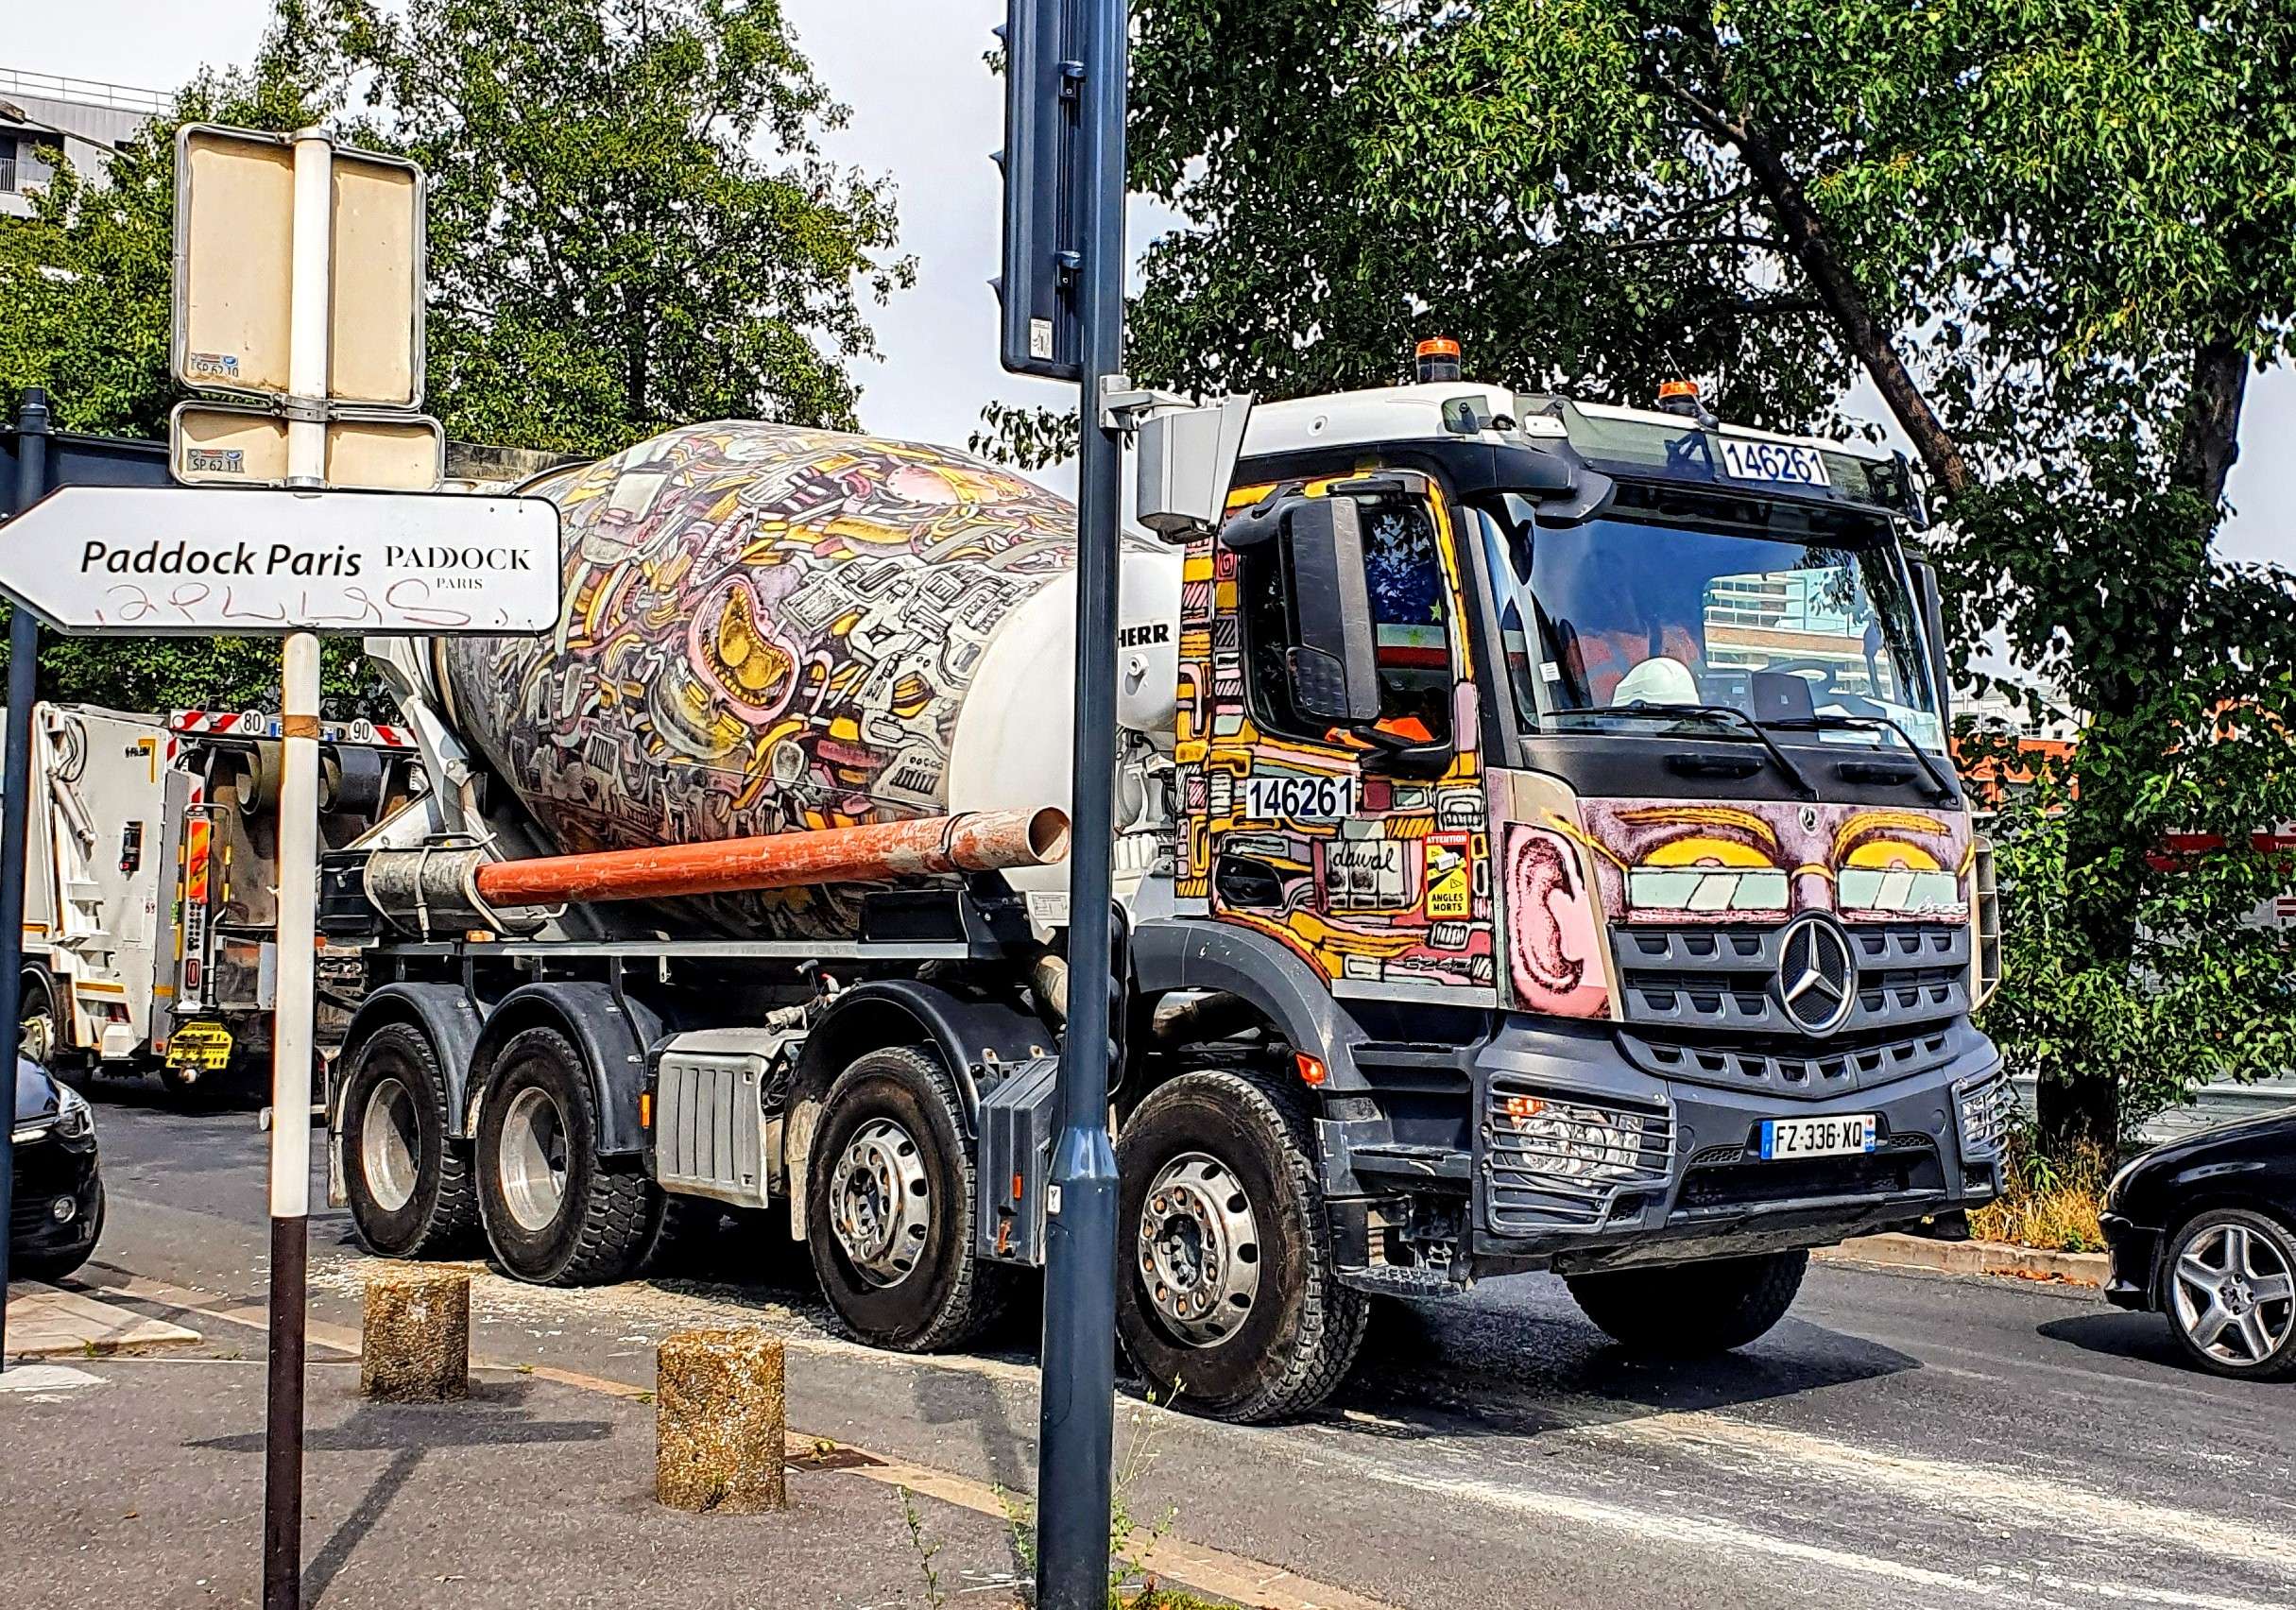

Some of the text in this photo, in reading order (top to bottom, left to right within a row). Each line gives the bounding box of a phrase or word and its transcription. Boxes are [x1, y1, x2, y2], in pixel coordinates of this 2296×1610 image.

[193, 458, 207, 471] SP
[210, 460, 223, 471] 62
[1727, 443, 1825, 484] 146261
[81, 540, 362, 576] Paddock Paris
[386, 545, 535, 571] PADDOCK
[437, 577, 484, 590] PARIS
[243, 712, 261, 731] 80
[353, 721, 370, 740] 90
[1250, 778, 1352, 816] 146261
[1427, 835, 1466, 844] ATTENTION
[1431, 893, 1464, 902] ANGLES
[1433, 902, 1463, 912] MORTS
[1776, 1122, 1862, 1153] FZ-336-XQ
